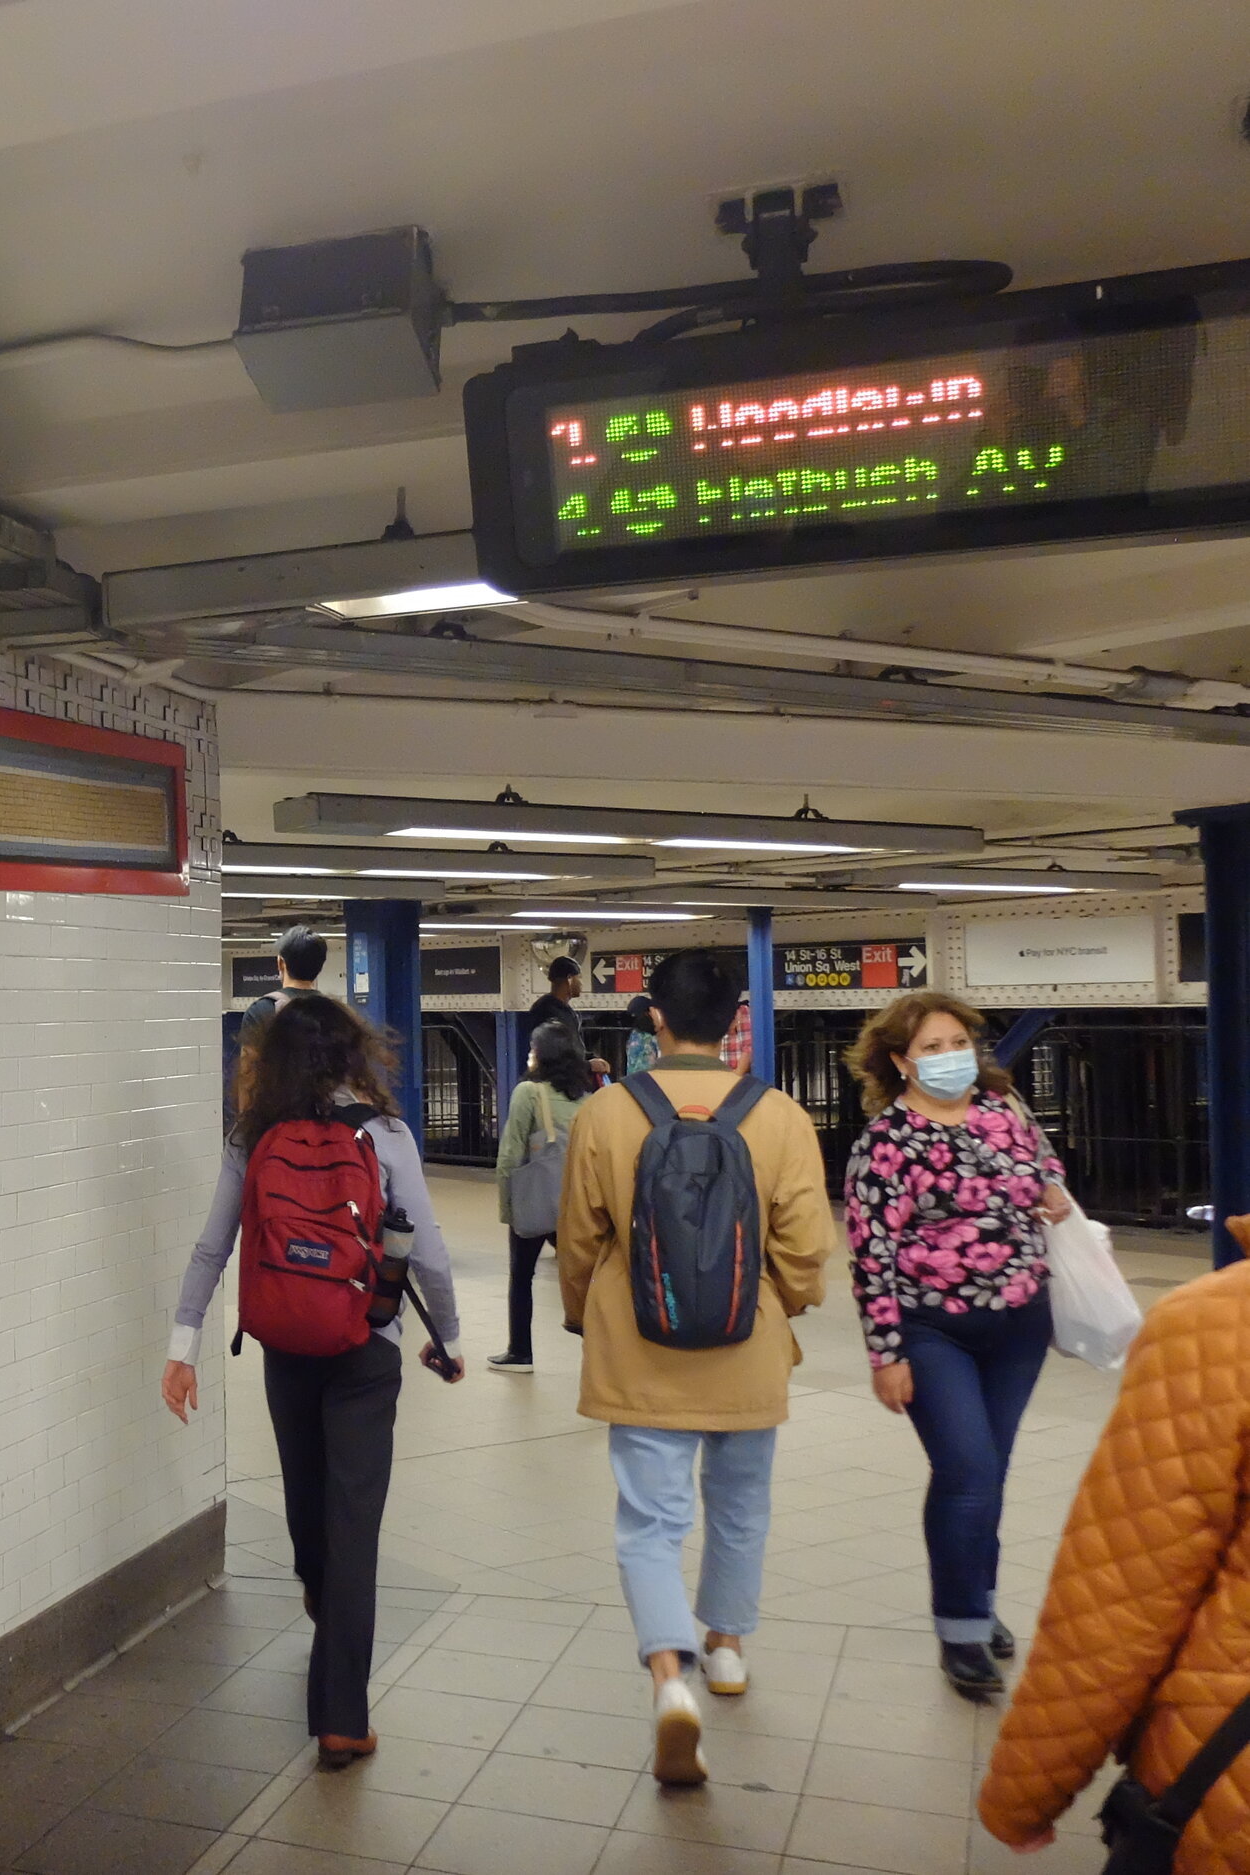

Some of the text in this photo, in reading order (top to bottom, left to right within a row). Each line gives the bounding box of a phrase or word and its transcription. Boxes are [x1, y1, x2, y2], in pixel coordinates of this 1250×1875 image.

[785, 949, 796, 960] 14
[830, 947, 842, 959] St
[862, 947, 893, 963] Exit
[1056, 946, 1077, 956] NYC
[616, 956, 639, 971] Exit
[785, 960, 861, 973] Union Sq West
